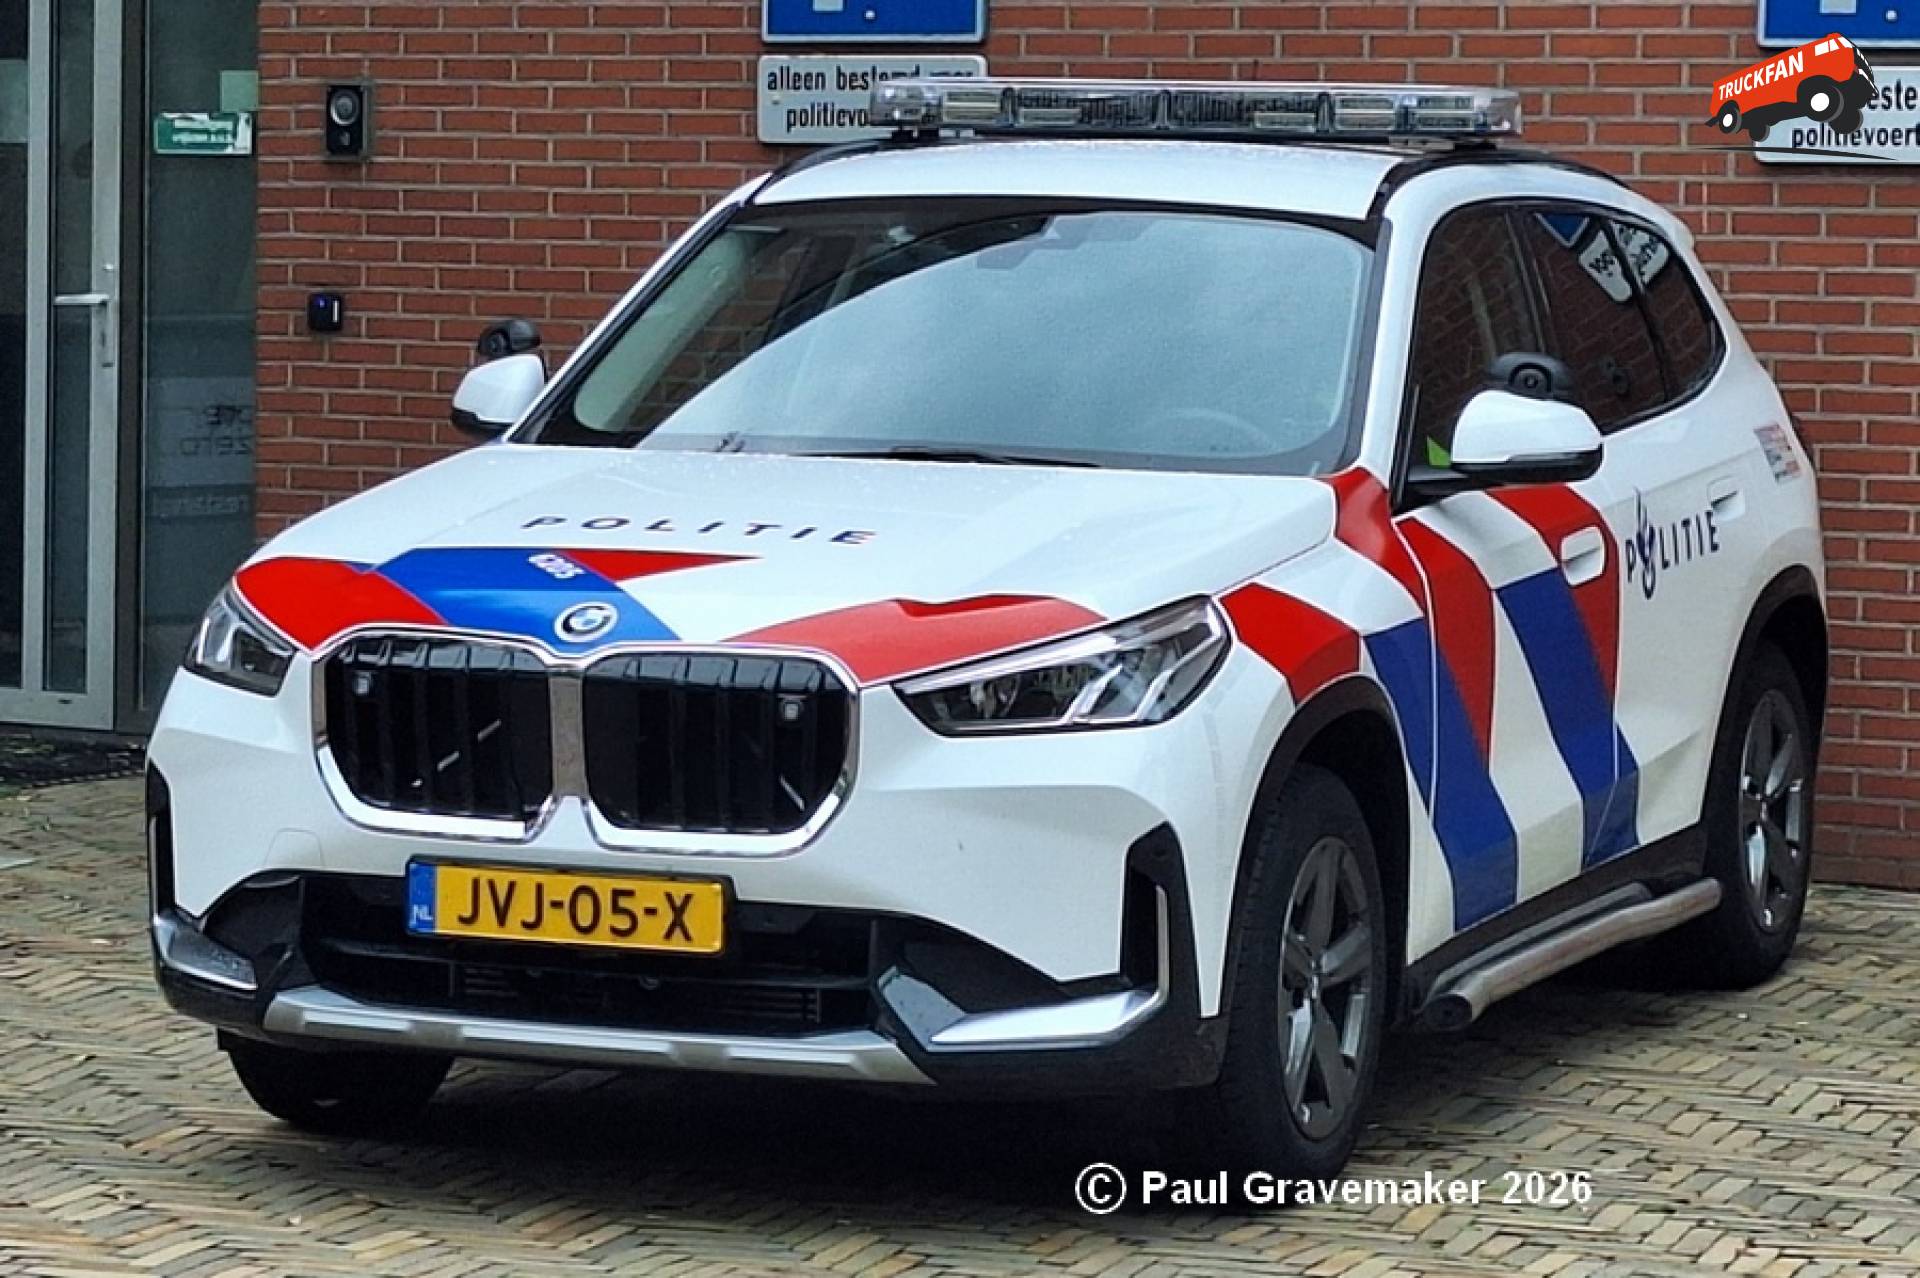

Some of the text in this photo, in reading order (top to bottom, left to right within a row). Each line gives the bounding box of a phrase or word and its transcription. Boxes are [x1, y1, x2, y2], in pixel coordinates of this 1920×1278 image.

[767, 64, 826, 91] alleen
[786, 102, 868, 133] politievo
[521, 515, 878, 545] POLITIE
[457, 877, 695, 942] JVJ-05-X
